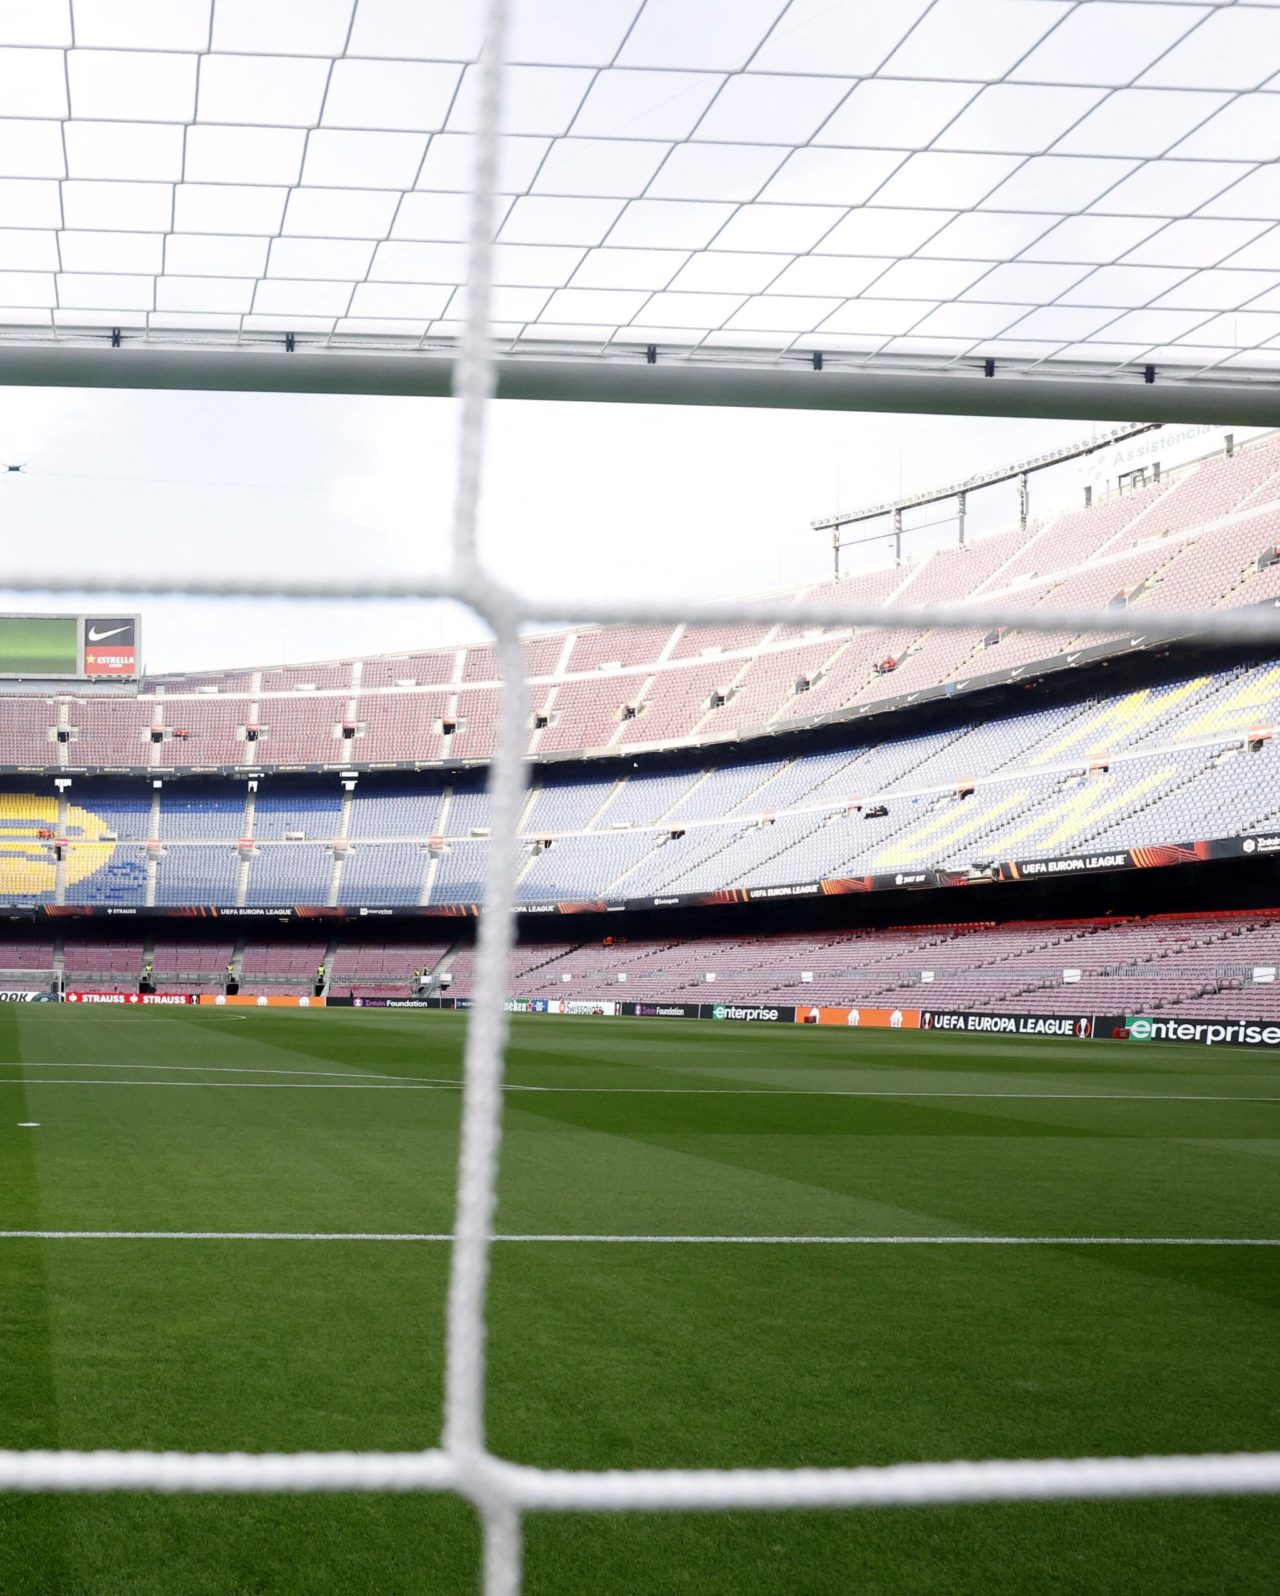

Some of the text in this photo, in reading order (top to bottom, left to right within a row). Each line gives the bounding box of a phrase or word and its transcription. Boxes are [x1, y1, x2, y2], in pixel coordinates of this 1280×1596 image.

[97, 656, 134, 664] ESTRELLA
[1023, 855, 1125, 874] UEFA EUROPA LEAGUE
[750, 884, 818, 898] UEFA EUROPA LEAGUE
[81, 994, 125, 1003] STRAUSS
[142, 995, 186, 1004] STRAUSS
[386, 999, 428, 1007] Foundation
[656, 1007, 684, 1016] Foundation
[714, 1006, 778, 1020] enterprise
[933, 1015, 1074, 1036] UEFA EUROPA LEAGUE
[1127, 1020, 1280, 1045] enterprise
